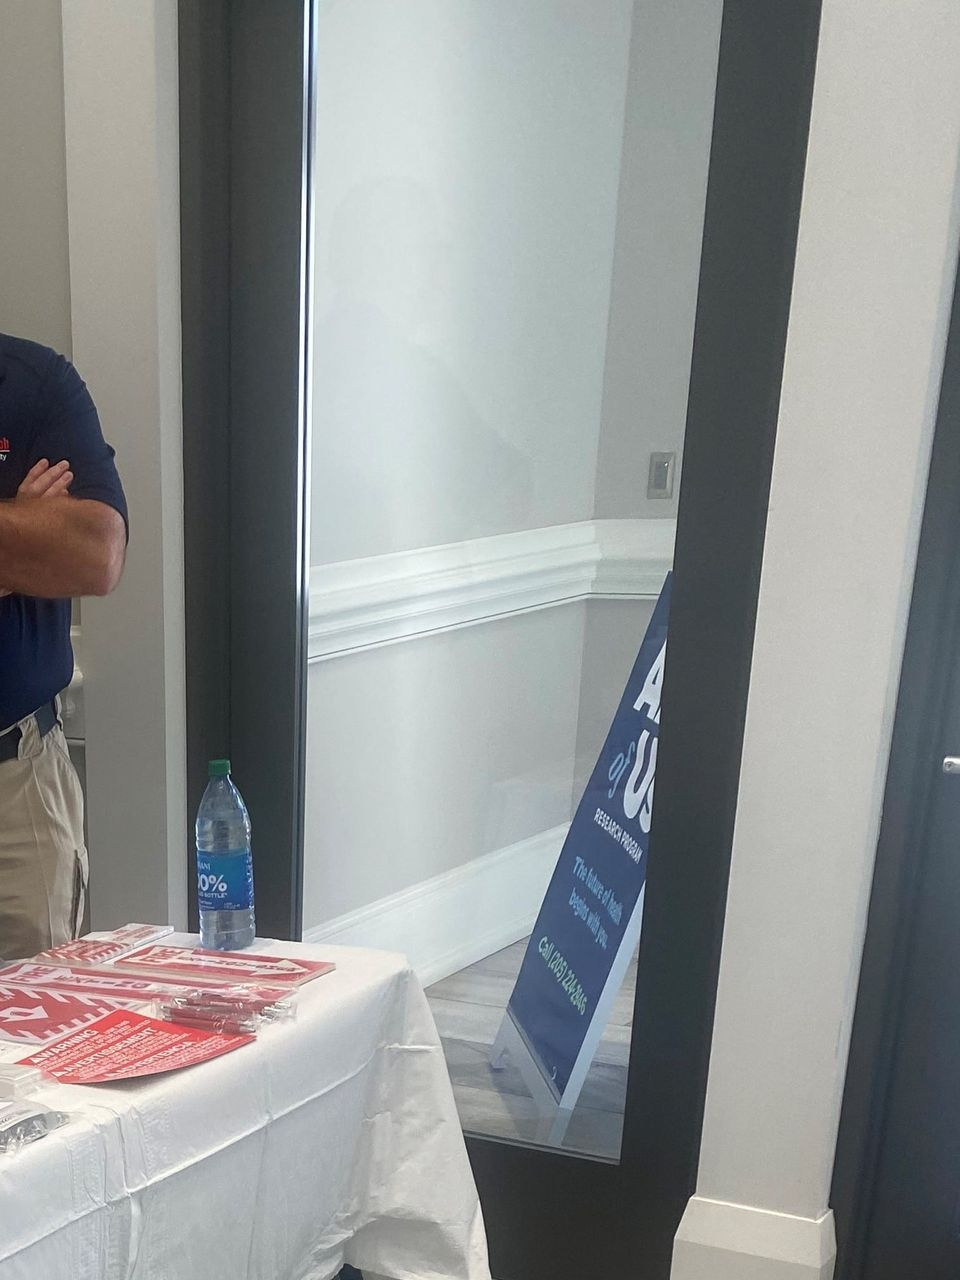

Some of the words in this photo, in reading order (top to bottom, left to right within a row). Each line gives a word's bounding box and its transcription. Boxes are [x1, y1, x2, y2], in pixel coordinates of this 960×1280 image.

[633, 638, 667, 725] A
[608, 741, 636, 799] of
[593, 807, 624, 841] RESEARCH
[198, 873, 228, 892] 0%
[573, 855, 589, 879] The
[143, 948, 184, 964] FIRE
[538, 935, 555, 960] Call
[548, 947, 569, 983] (205)
[11, 966, 56, 982] FIRE
[41, 1029, 99, 1060] WARNING
